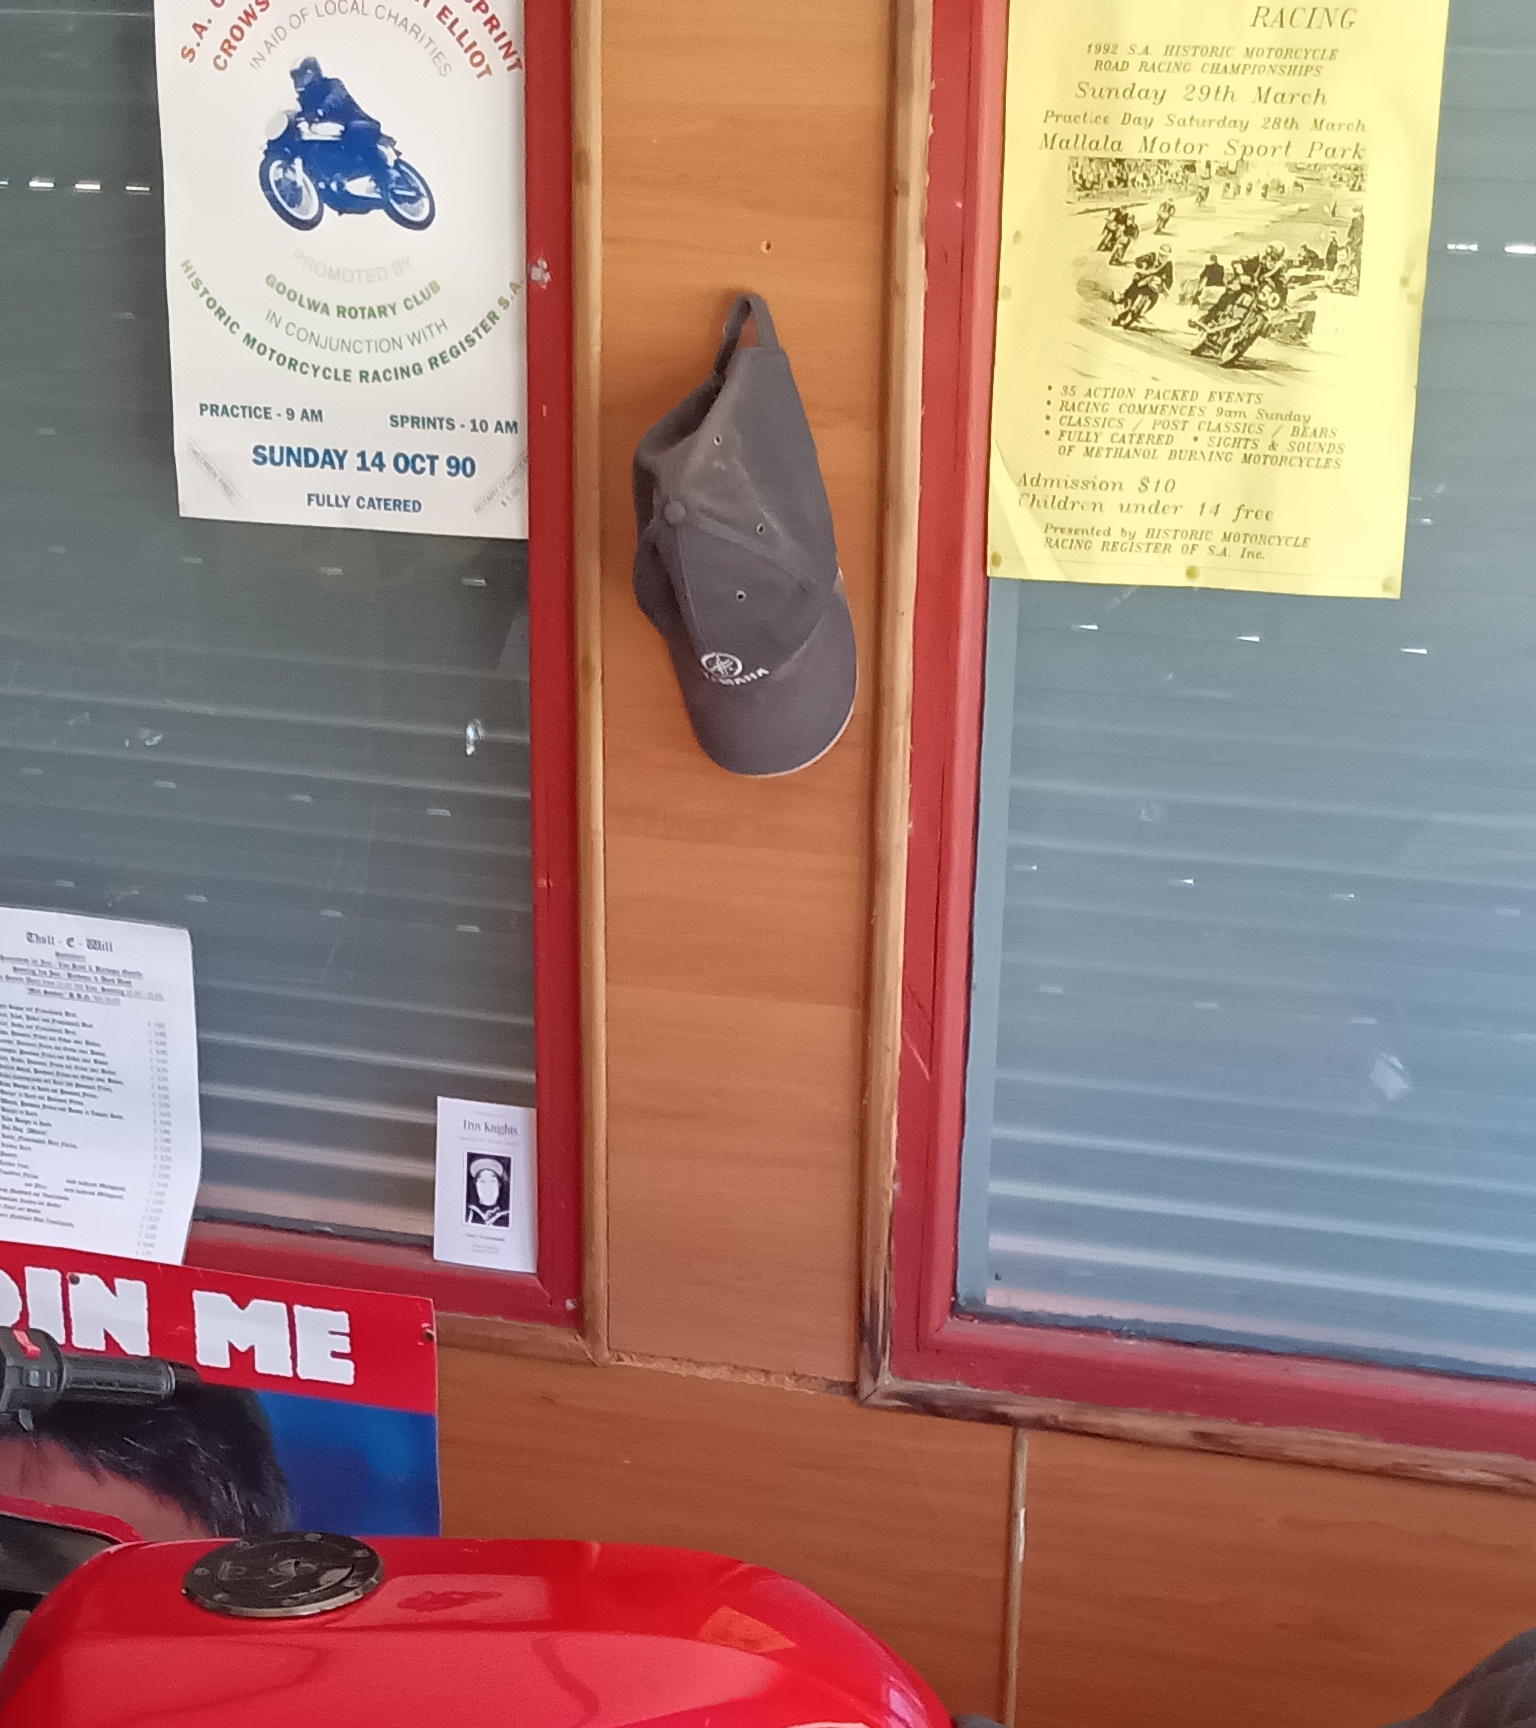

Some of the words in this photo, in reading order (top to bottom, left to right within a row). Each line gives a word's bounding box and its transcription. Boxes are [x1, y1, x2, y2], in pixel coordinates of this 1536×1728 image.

[1250, 5, 1358, 30] RACING
[180, 17, 213, 63] S.A.
[248, 52, 267, 71] IN
[264, 25, 288, 55] AID
[289, 7, 309, 30] OF
[316, 0, 369, 18] LOCAL
[375, 4, 453, 78] CHARITIES
[436, 5, 493, 79] ELLIOT
[470, 0, 523, 73] PRINT
[1086, 42, 1119, 55] 1992
[1163, 44, 1235, 58] HISTORIC
[1243, 46, 1339, 62] MOTORCYCLE
[1093, 59, 1130, 73] ROAD
[1138, 60, 1192, 75] RACING
[1200, 62, 1324, 78] CHAMPIONSHIPS
[1074, 80, 1167, 106] Sunday
[1182, 83, 1237, 103] 29th
[1251, 85, 1328, 106] March
[1042, 109, 1110, 126] Practice
[1120, 111, 1154, 130] Day
[1164, 112, 1250, 133] Saturday
[1260, 116, 1300, 131] 28th
[1309, 118, 1366, 133] March
[1038, 131, 1124, 153] Mallala
[1137, 135, 1210, 155] Motor
[1223, 138, 1292, 162] Sport
[1306, 140, 1367, 160] Park
[291, 249, 389, 284] PROMOTED
[392, 254, 413, 276] BY
[265, 273, 330, 317] GOOLWA
[336, 303, 397, 320] ROTARY
[402, 280, 441, 311] CLUB
[180, 259, 241, 335] HISTORIC
[242, 332, 352, 383] MOTORCYCLE
[359, 361, 424, 384] RACING
[428, 310, 500, 371] REGISTER
[497, 278, 525, 311] S.A.
[265, 308, 282, 329] IN
[285, 321, 404, 354] CONJUNCTION
[406, 318, 449, 348] WITH
[1083, 386, 1136, 400] ACTION
[1144, 388, 1199, 402] PACKED
[1207, 391, 1264, 405] EVENTS
[198, 402, 273, 421] PRACTICE
[286, 407, 295, 421] 9
[300, 408, 324, 423] AM
[389, 414, 455, 431] SPRINTS
[470, 418, 489, 433] 10
[494, 419, 519, 434] AM
[1059, 400, 1109, 414] RACING
[1118, 402, 1207, 418] COMMENCES
[1215, 406, 1247, 419] 9am
[1255, 408, 1311, 425] Sunday
[1058, 415, 1125, 430] CLASSICS
[1152, 418, 1190, 432] POST
[1197, 420, 1265, 435] CLASSICS
[1290, 425, 1339, 439] BEARS
[1057, 430, 1102, 444] FULLY
[1109, 432, 1174, 446] CATERED
[1207, 435, 1260, 450] SIGHTS
[1286, 440, 1346, 455] SOUNDS
[251, 444, 348, 471] SUNDAY
[356, 450, 386, 473] 14
[392, 452, 439, 477] OCT
[446, 455, 476, 479] 90
[1057, 445, 1076, 457] OF
[1083, 446, 1159, 460] METHANOL
[1167, 449, 1234, 464] BURNING
[1241, 453, 1343, 470] MOTORCYCLES
[1017, 472, 1125, 493] Admission
[1137, 476, 1177, 494] $10
[306, 493, 351, 508] FULLY
[356, 495, 422, 513] CATERED
[1018, 493, 1105, 514] Children
[1118, 499, 1184, 516] under
[1198, 502, 1221, 517] 14
[1231, 504, 1275, 523] free
[1044, 522, 1112, 537] Presented
[1120, 527, 1137, 541] by
[1145, 527, 1214, 542] HISTORIC
[1220, 531, 1311, 549] MOTORCYCLE
[1044, 537, 1093, 551] RACING
[1101, 540, 1172, 555] REGISTER
[1181, 542, 1199, 556] OF
[192, 1290, 355, 1386] ME
